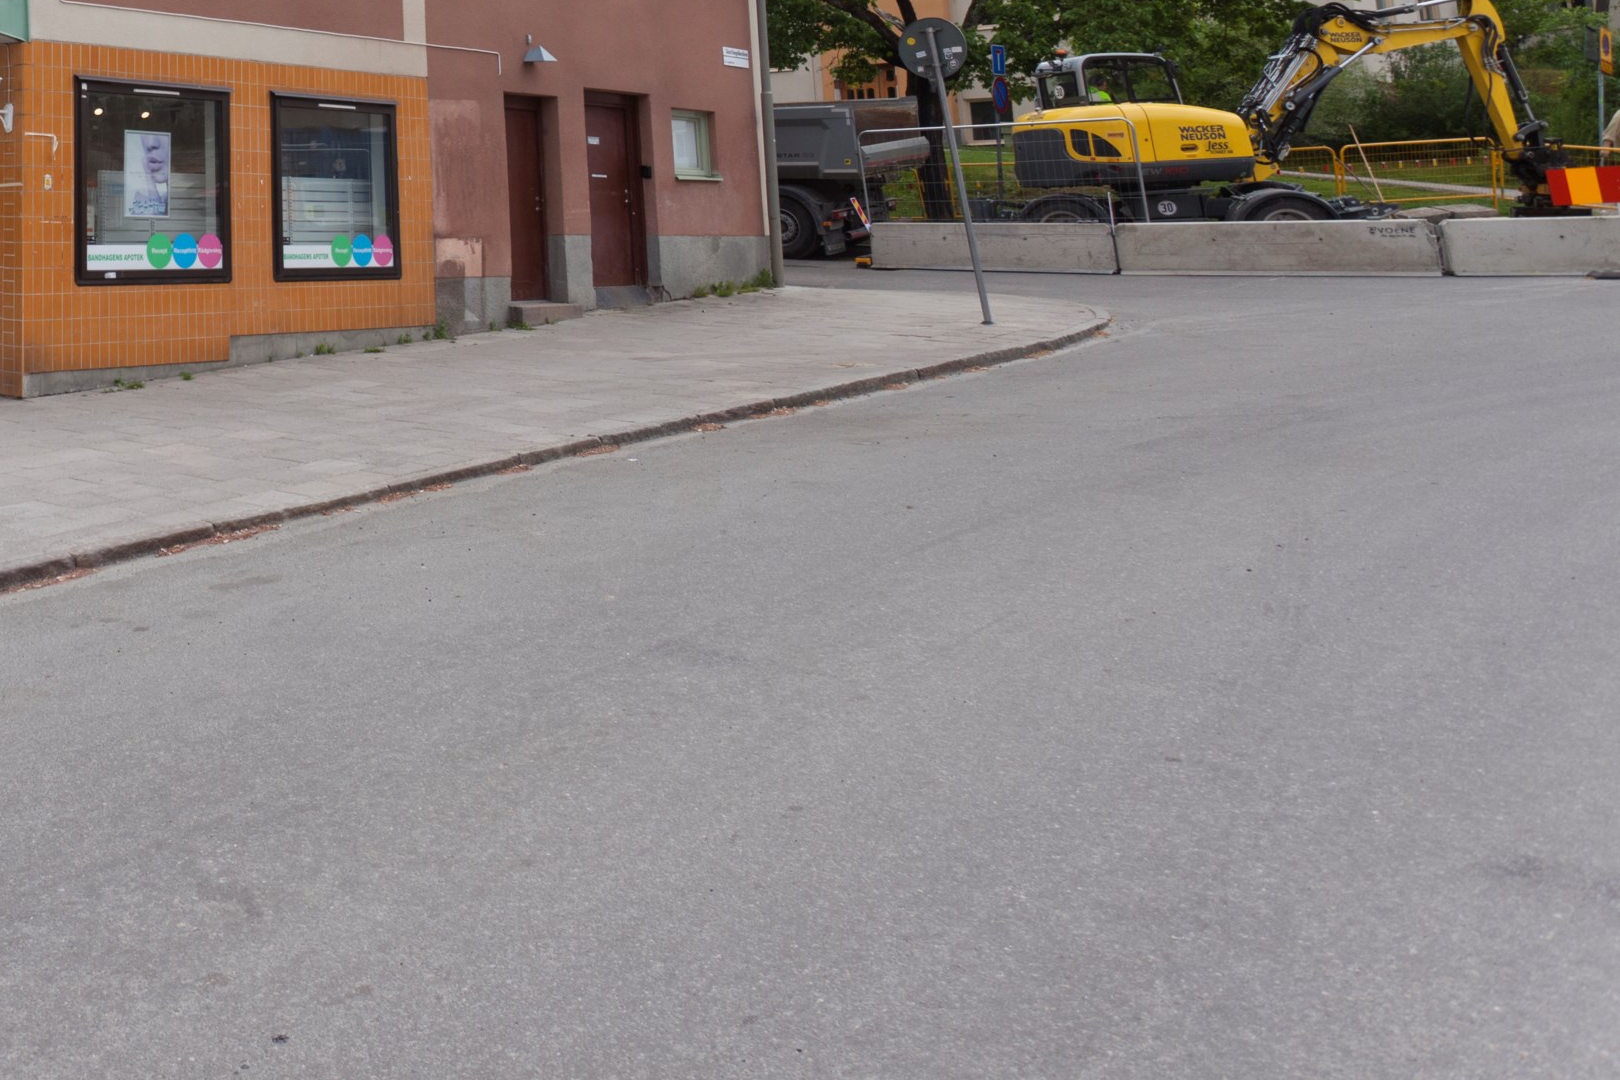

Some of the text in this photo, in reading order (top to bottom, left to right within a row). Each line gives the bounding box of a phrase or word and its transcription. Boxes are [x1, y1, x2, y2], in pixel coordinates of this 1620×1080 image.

[1178, 124, 1225, 133] WACKER
[1180, 132, 1227, 142] NEUSON
[1160, 202, 1173, 213] 30
